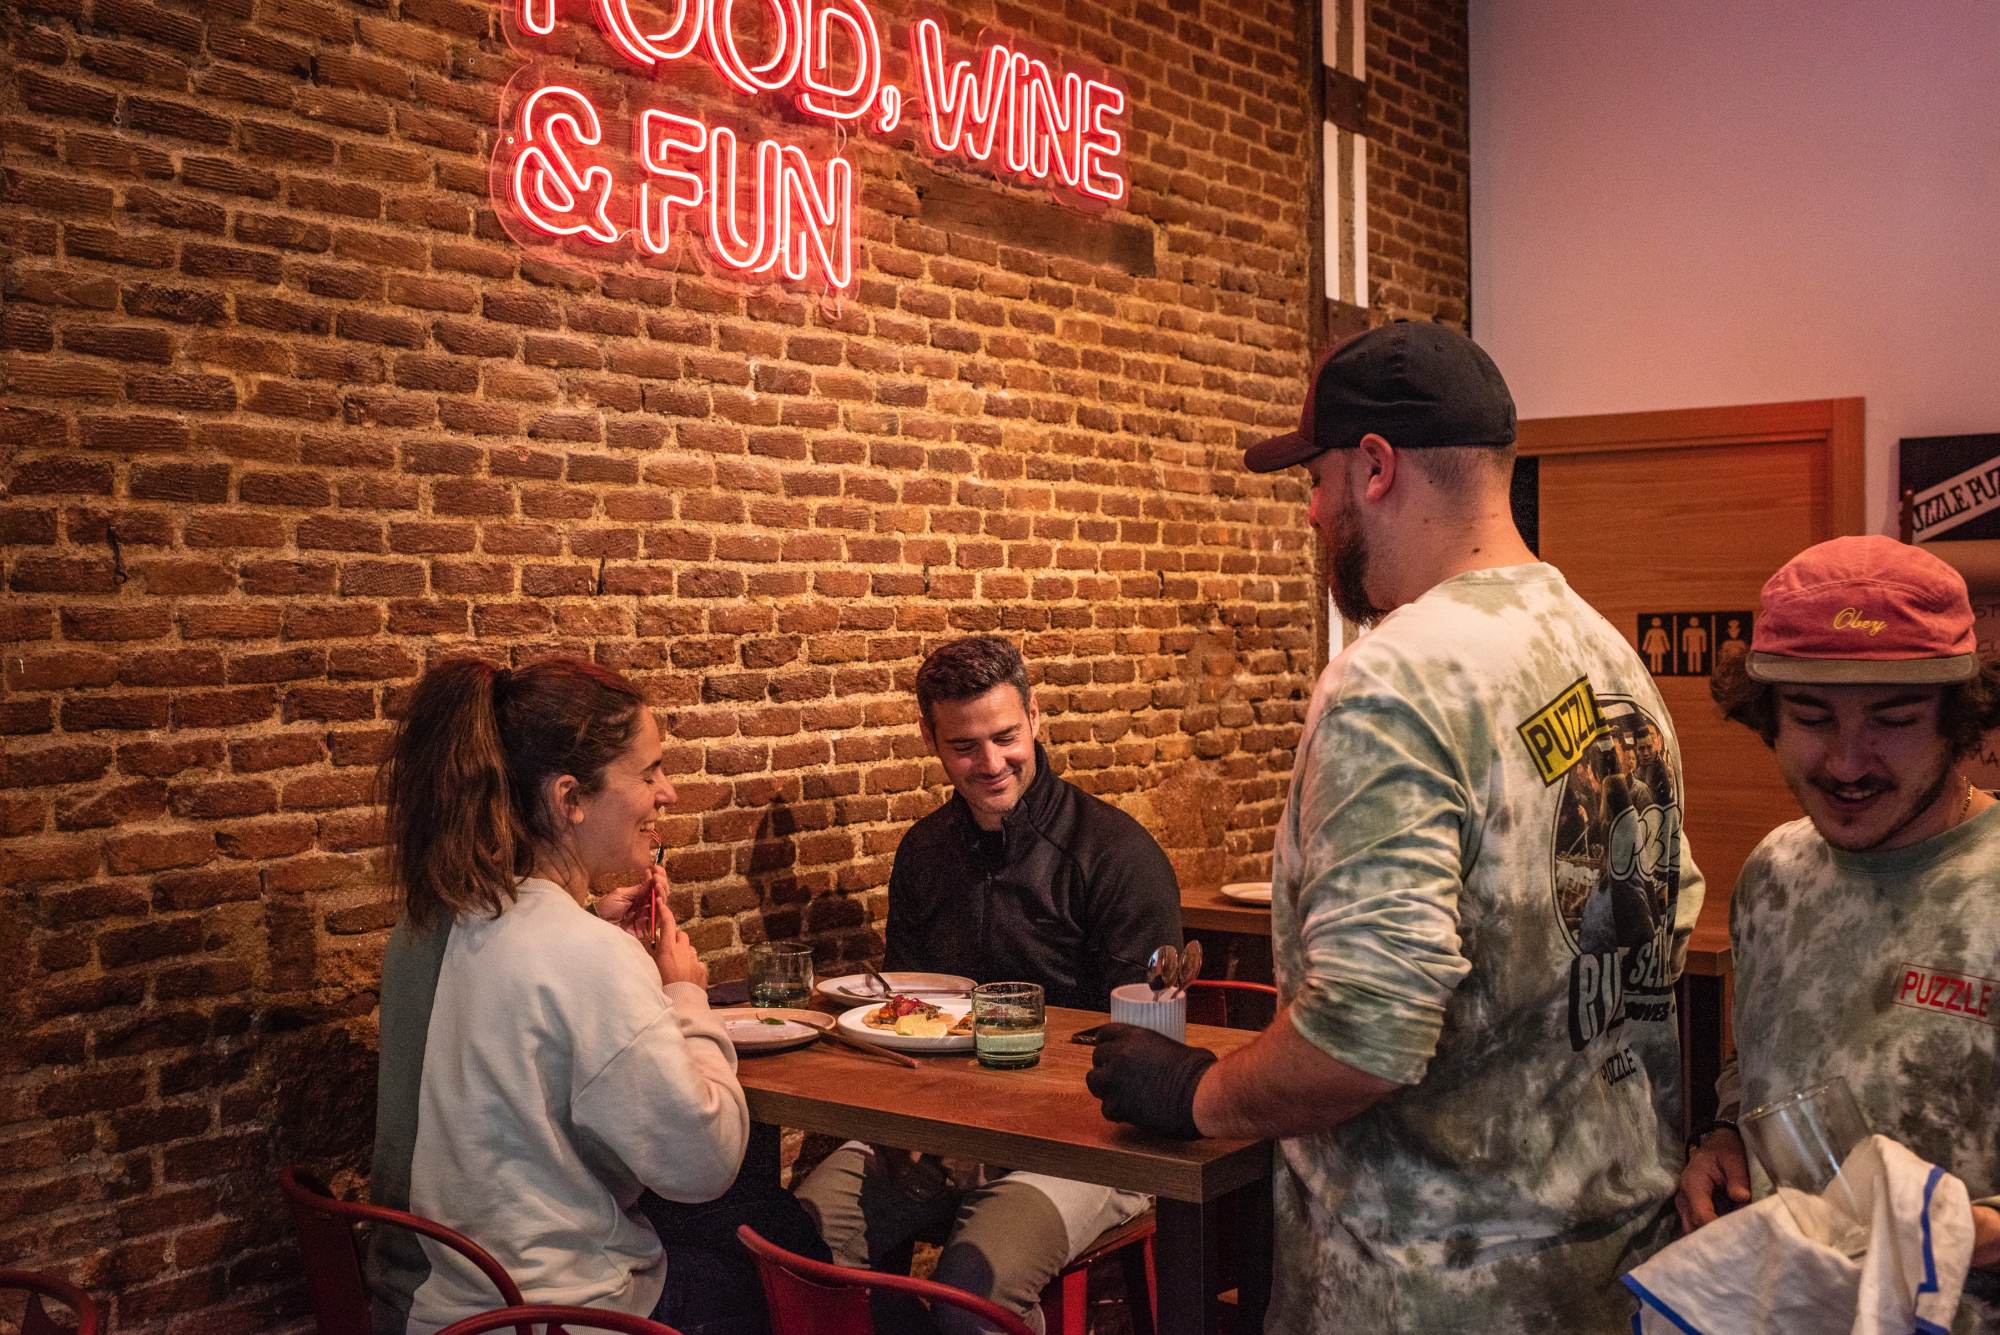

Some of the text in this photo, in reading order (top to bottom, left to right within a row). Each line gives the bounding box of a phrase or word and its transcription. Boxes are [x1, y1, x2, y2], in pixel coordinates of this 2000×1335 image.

[516, 0, 1125, 200] OD, WINE
[514, 85, 852, 288] & FUN
[1911, 465, 2000, 533] UZZLE PU
[1900, 970, 1992, 1017] PUZZLE
